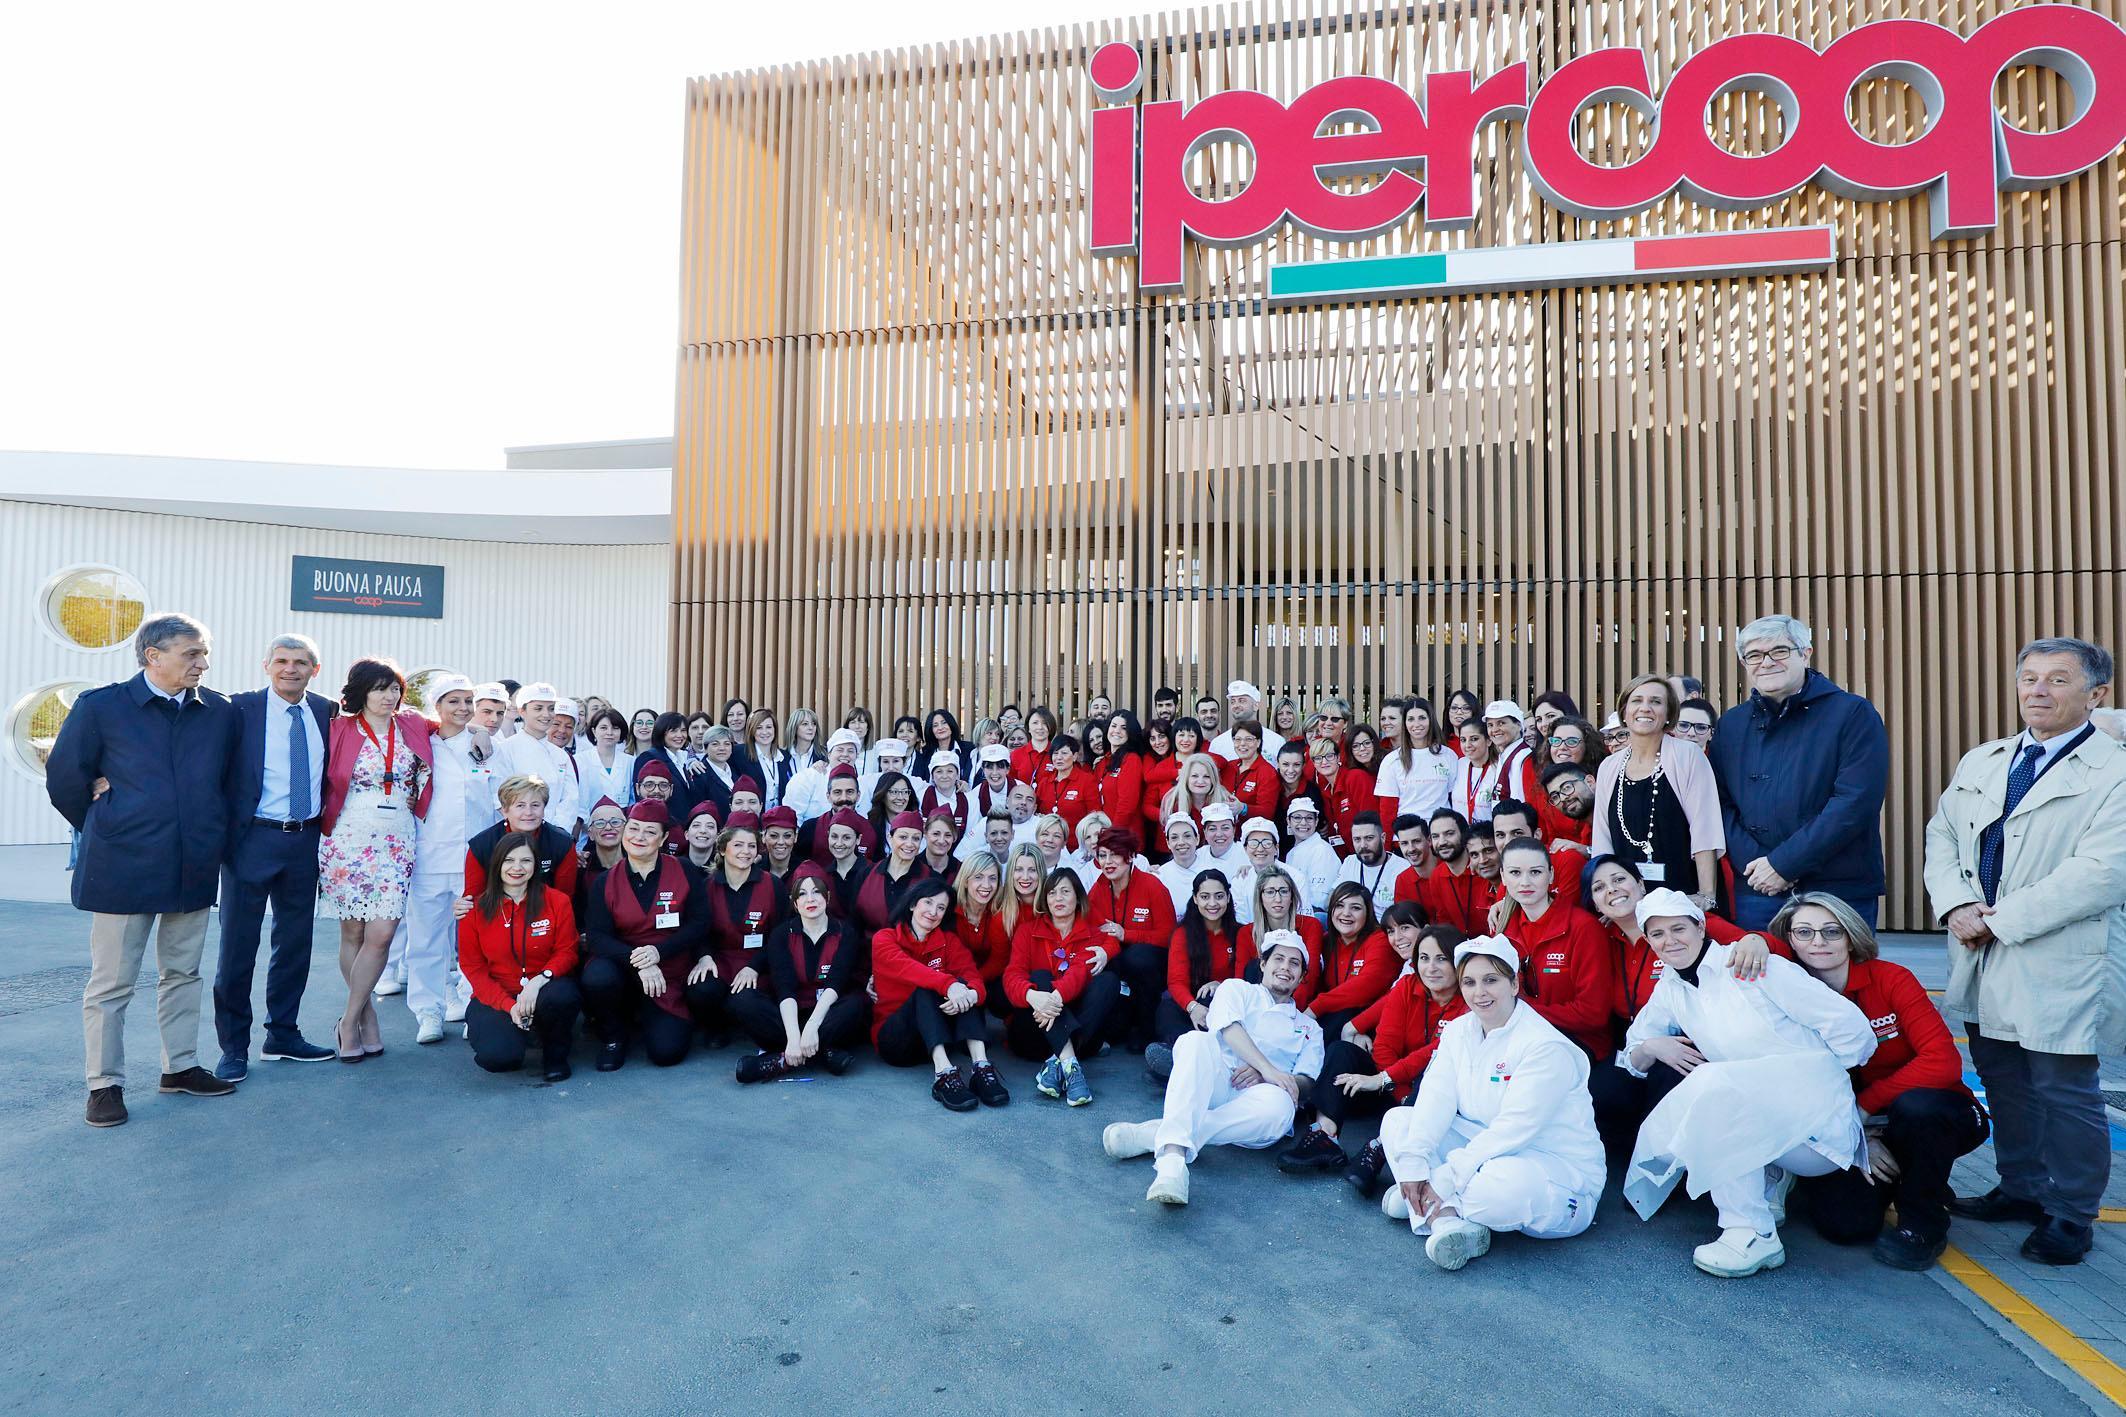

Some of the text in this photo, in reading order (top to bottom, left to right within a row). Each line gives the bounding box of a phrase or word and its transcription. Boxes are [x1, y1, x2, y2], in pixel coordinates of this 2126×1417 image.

[1089, 3, 2126, 297] ipercoop
[313, 569, 423, 598] BUONA PAUSA
[353, 596, 385, 607] coop
[1134, 907, 1150, 916] coop
[530, 918, 550, 928] coop
[1547, 953, 1565, 962] coop
[1870, 1012, 1897, 1028] coop
